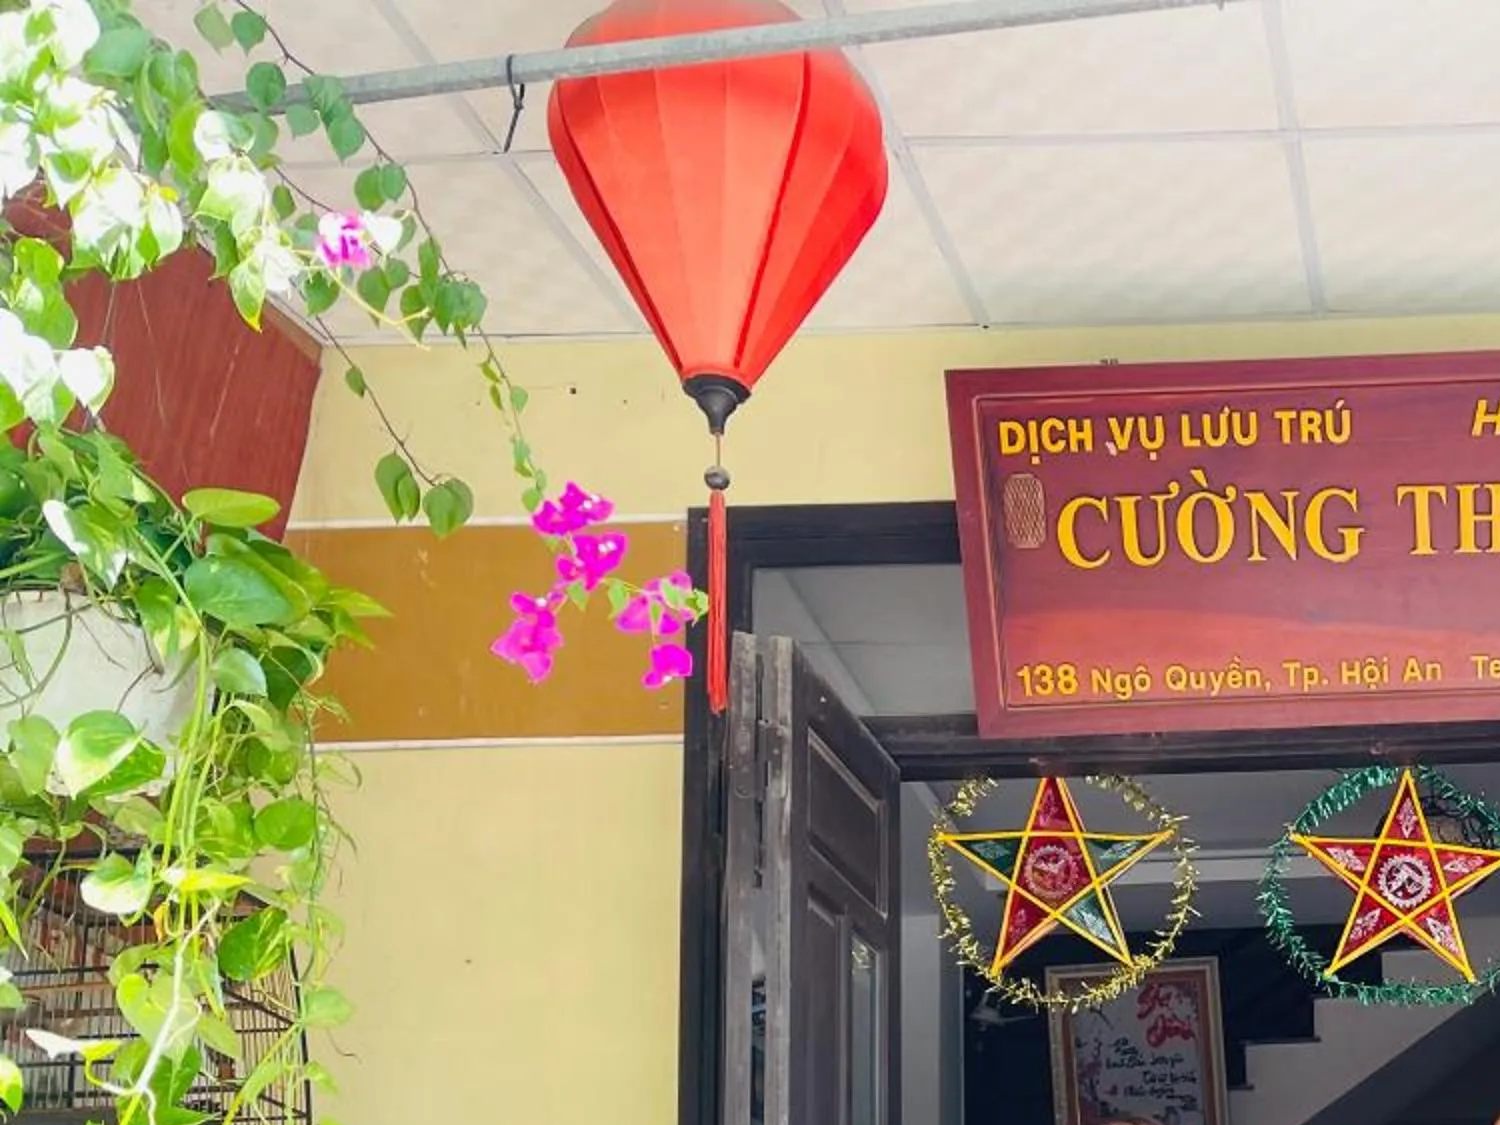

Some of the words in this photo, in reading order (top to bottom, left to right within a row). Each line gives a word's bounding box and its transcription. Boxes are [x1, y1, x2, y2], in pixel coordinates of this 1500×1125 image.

[1000, 418, 1094, 465] DỊCH
[1108, 414, 1165, 460] VỤ
[1181, 406, 1258, 448] LƯU
[1274, 400, 1352, 444] TRÚ
[1057, 468, 1365, 569] CƯỜNG
[1017, 664, 1078, 697] 138
[1091, 666, 1152, 699] Ngô
[1283, 660, 1328, 691] Tp.
[1341, 656, 1390, 689] Hội
[1403, 658, 1442, 682] An
